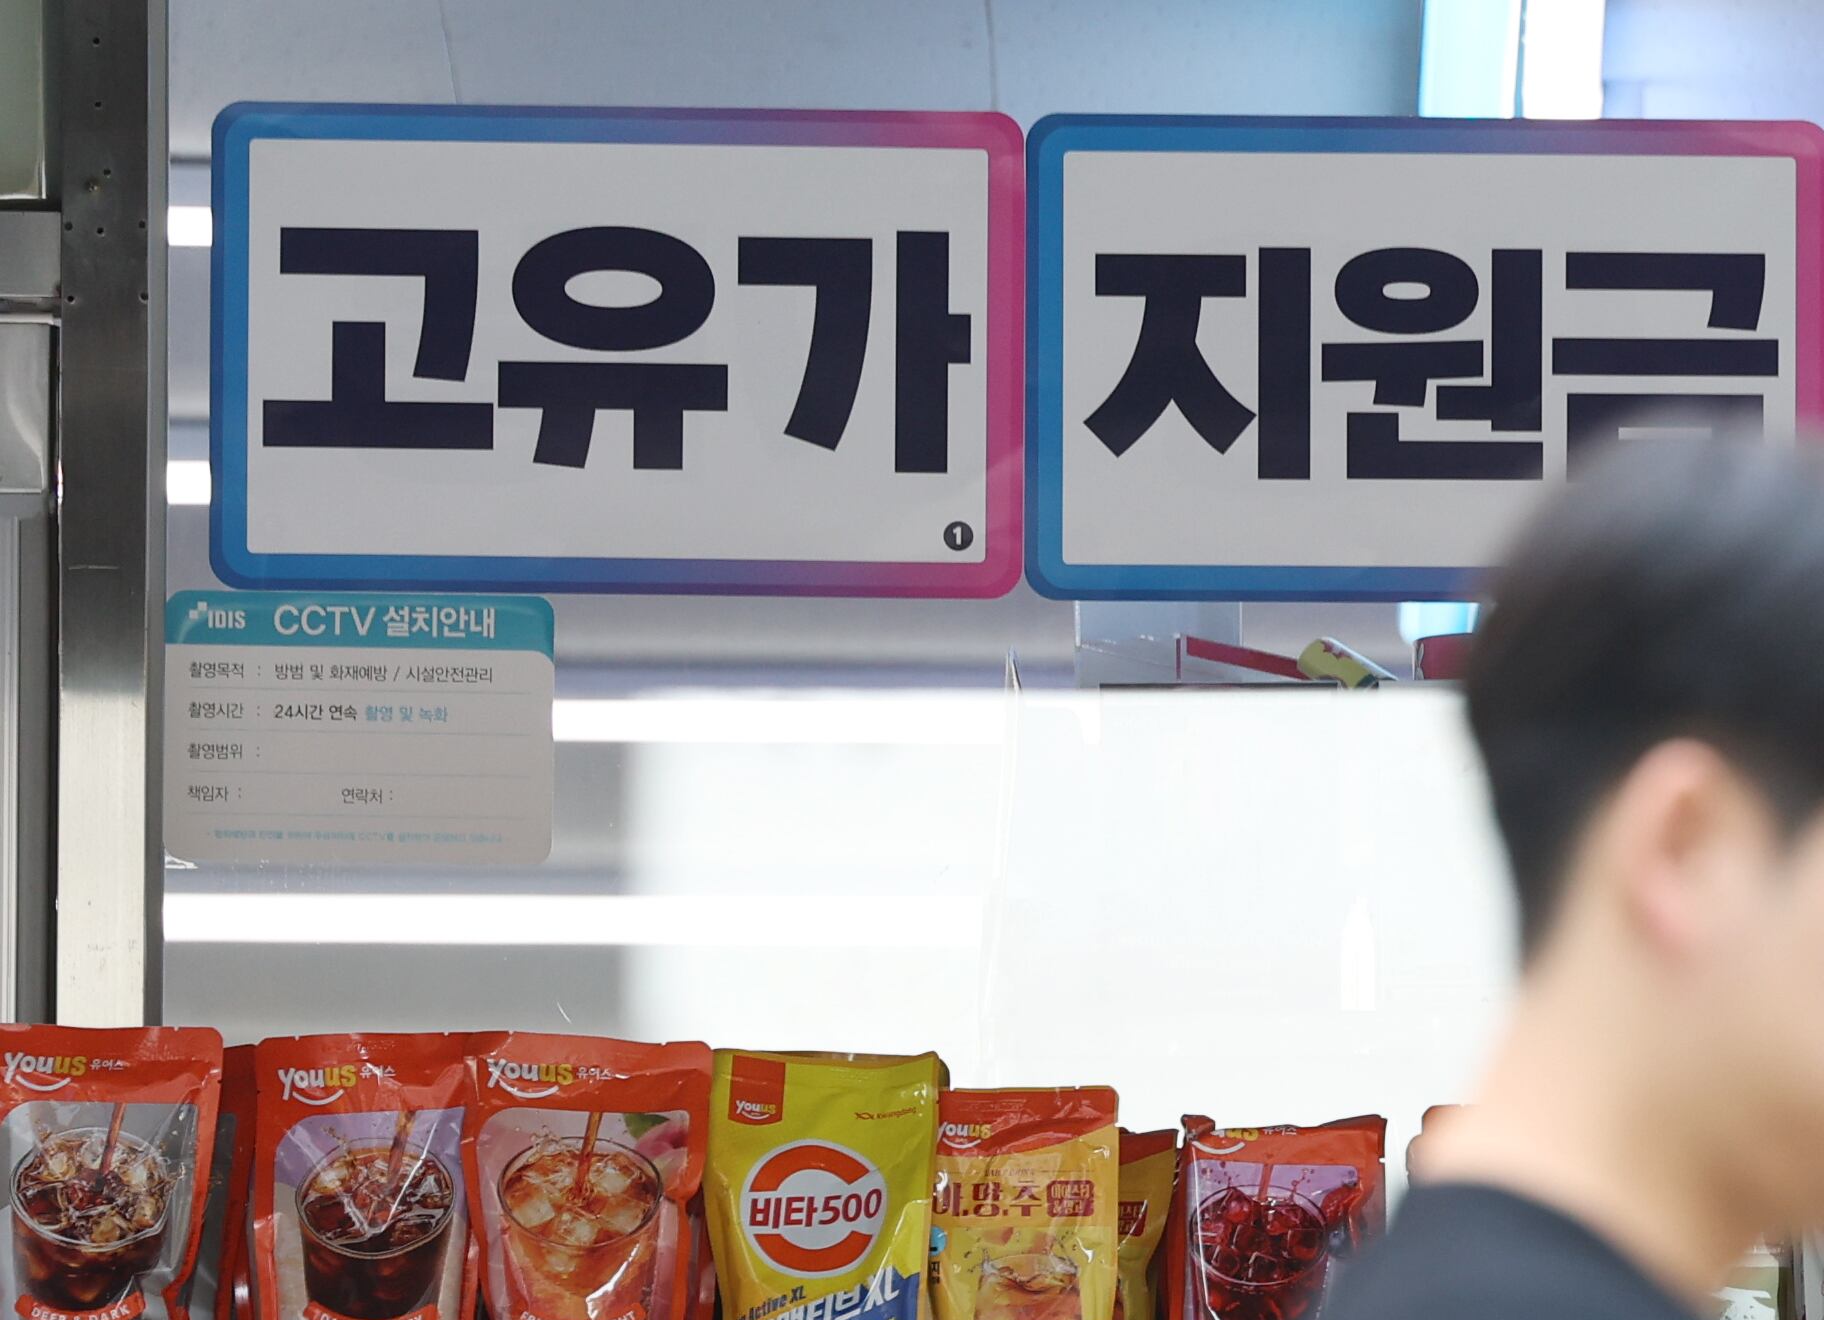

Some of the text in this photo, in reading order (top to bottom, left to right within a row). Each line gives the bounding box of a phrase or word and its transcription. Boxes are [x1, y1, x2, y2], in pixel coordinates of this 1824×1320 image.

[263, 226, 971, 473] 고유가
[1083, 247, 1779, 483] 지원금
[208, 610, 246, 629] IDIS
[274, 605, 495, 639] CCTV 설치안내
[188, 662, 493, 684] 촬영목적 방범 및 화재예방 시설안전관리
[188, 702, 244, 719] 촬영시간
[274, 703, 324, 721] 24시간
[328, 704, 358, 722] 연속
[187, 743, 243, 760] 촬영범위
[187, 785, 384, 804] 책임자 연락처
[736, 1099, 777, 1118] youus
[749, 1188, 882, 1230] 비타500
